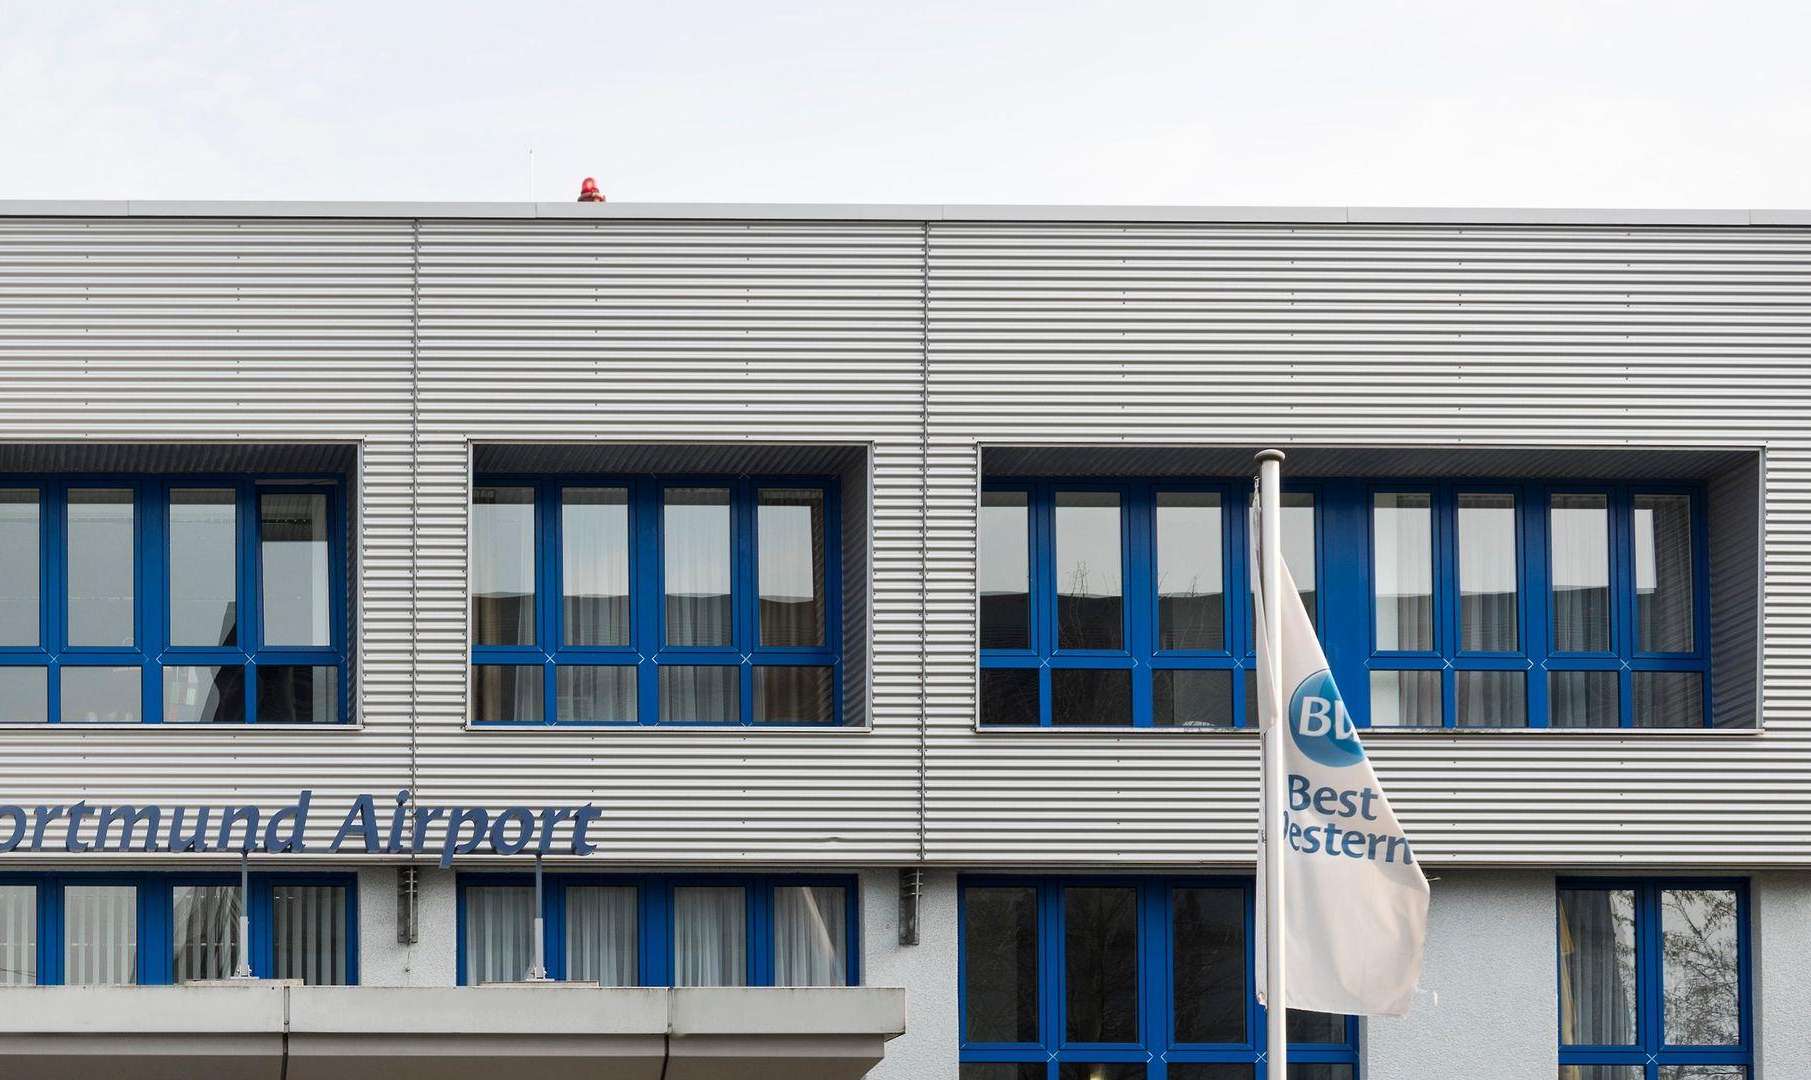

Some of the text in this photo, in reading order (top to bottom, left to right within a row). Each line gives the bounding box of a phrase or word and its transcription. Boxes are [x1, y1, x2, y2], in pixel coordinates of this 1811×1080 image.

[1288, 774, 1379, 821] Best
[327, 789, 602, 869] Airport
[1283, 810, 1414, 865] estern
